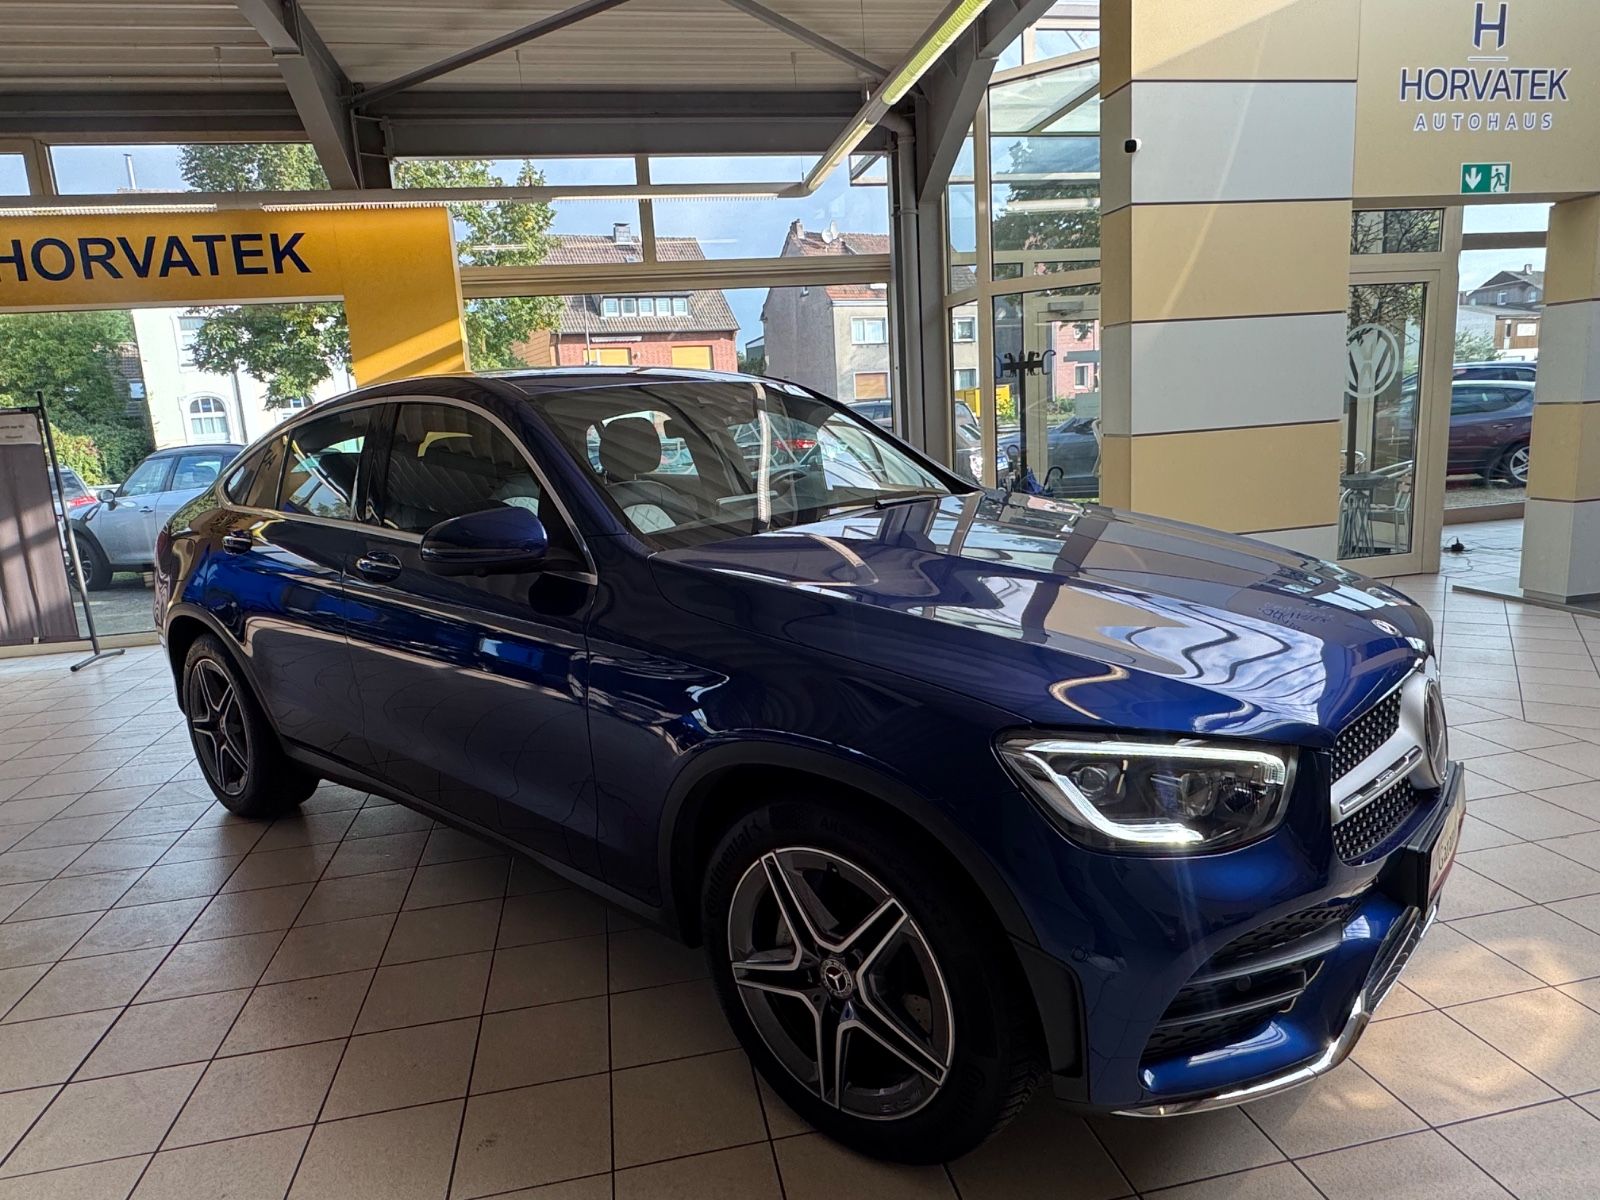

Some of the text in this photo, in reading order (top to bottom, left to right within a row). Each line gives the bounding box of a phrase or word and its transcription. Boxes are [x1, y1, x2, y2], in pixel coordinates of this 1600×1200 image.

[1399, 67, 1570, 102] HORVATEK
[1413, 112, 1553, 132] AUTOHAUS
[0, 232, 311, 281] HORVATEK
[703, 823, 755, 918] Continental
